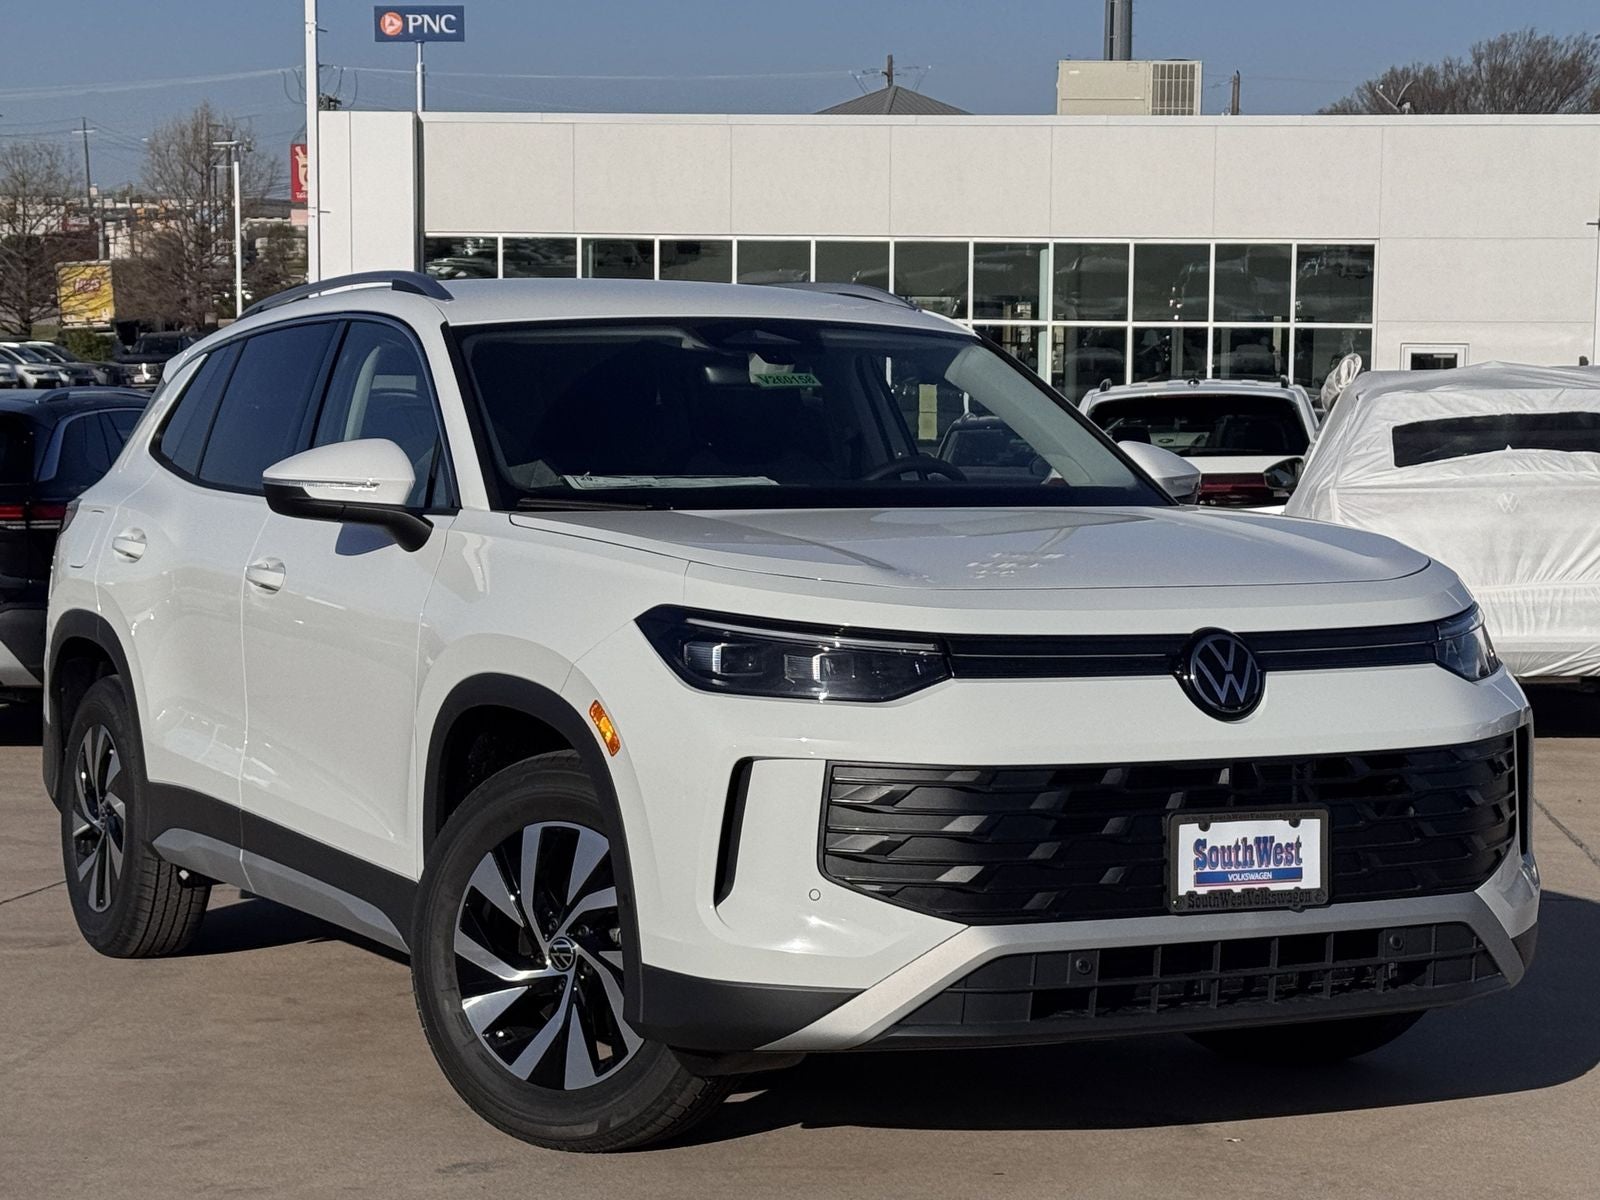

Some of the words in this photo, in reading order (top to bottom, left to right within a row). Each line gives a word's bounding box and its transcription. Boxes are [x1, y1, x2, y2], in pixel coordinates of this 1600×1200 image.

[405, 14, 457, 34] PNC
[757, 374, 815, 385] V260158
[1193, 835, 1302, 870] SouthWest
[1228, 871, 1273, 882] VOLKSWAGEN
